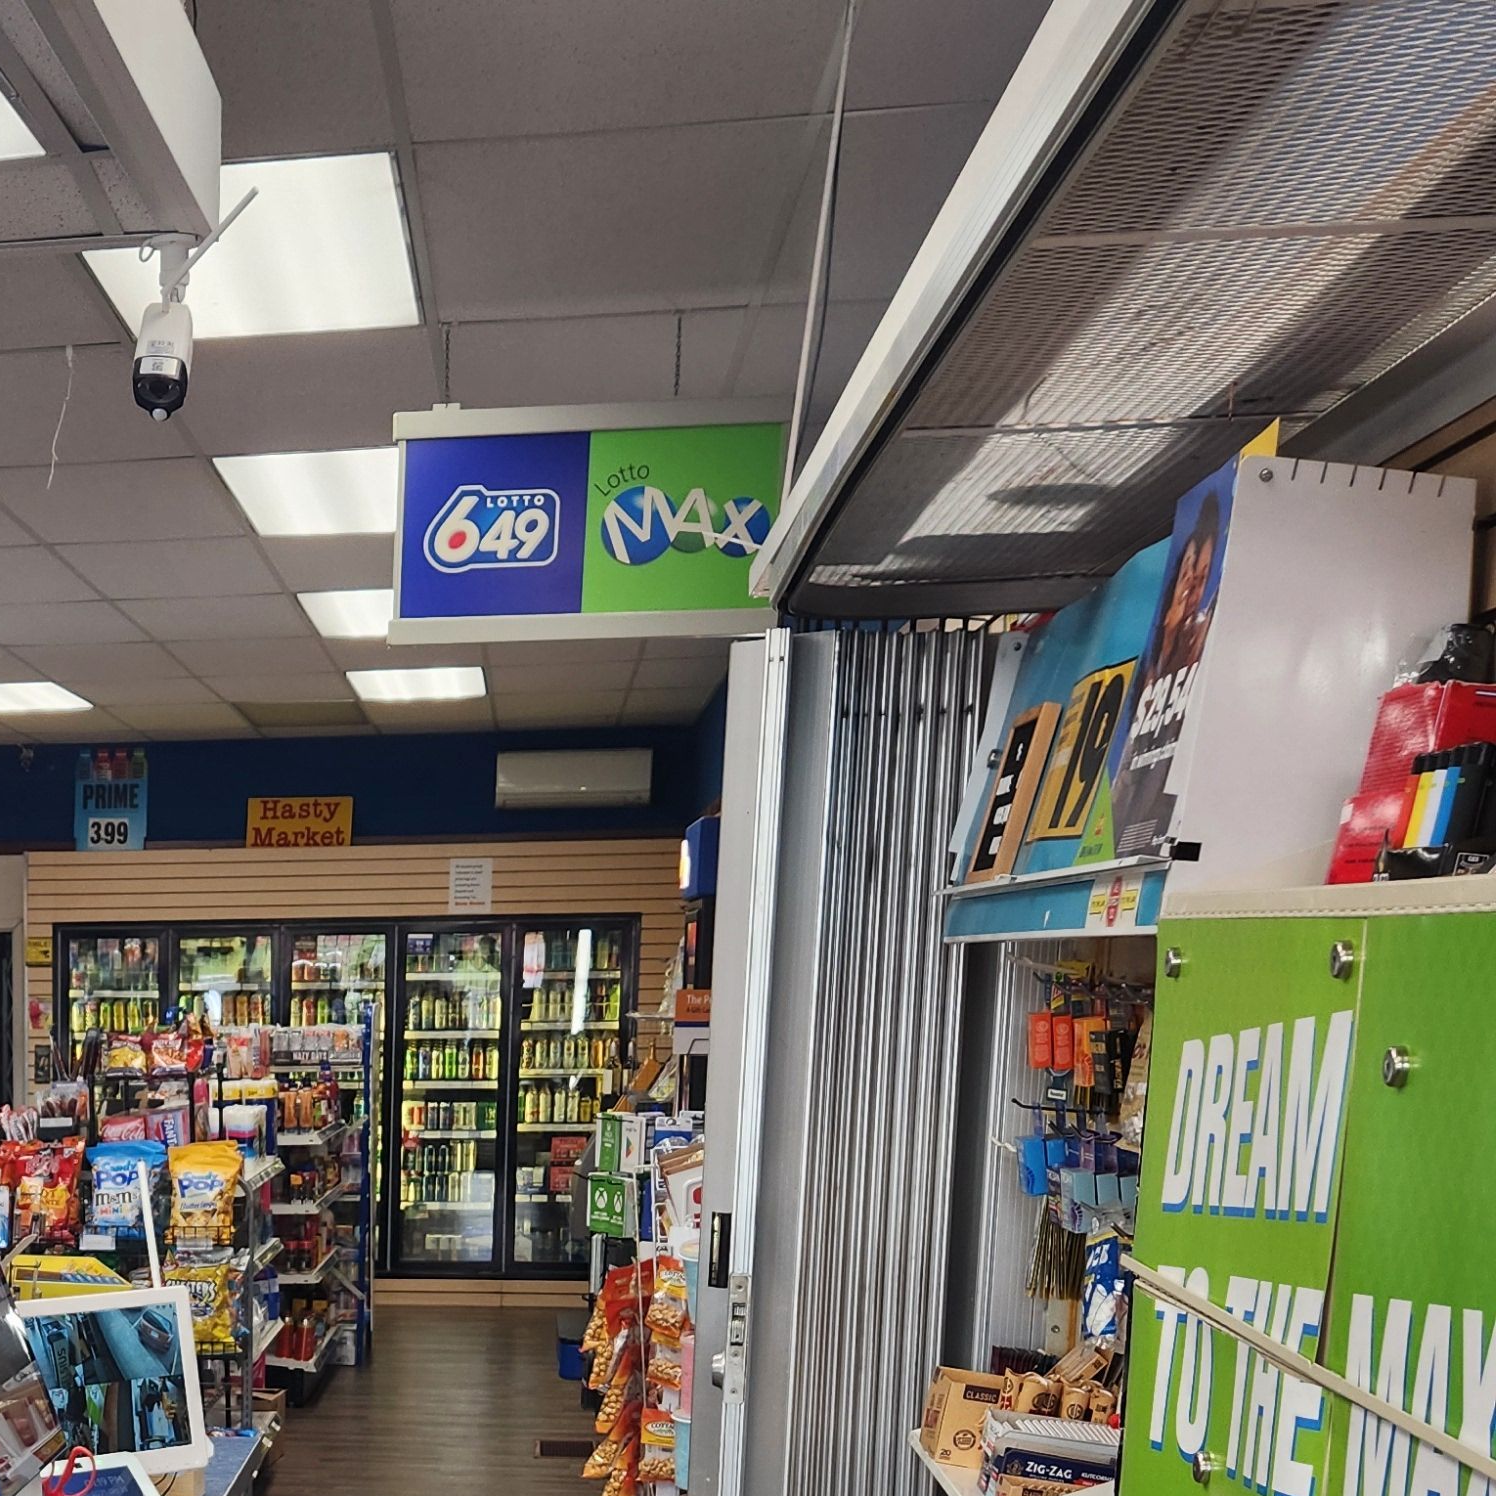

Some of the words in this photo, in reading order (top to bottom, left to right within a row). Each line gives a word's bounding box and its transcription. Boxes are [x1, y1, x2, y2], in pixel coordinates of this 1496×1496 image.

[594, 462, 650, 496] Lotto
[487, 495, 544, 508] LOTTO
[434, 496, 550, 563] 649
[604, 486, 765, 564] MAX
[82, 783, 139, 809] PRIME
[259, 799, 340, 823] Hasty
[89, 820, 129, 845] 399
[250, 825, 345, 848] Market
[1161, 1010, 1354, 1223] DREAM
[95, 1170, 139, 1190] Pop
[177, 1177, 224, 1198] Pop
[1149, 1265, 1213, 1462] TO
[966, 1390, 997, 1403] CLASSIC
[1025, 1461, 1073, 1480] ZIG-ZAG
